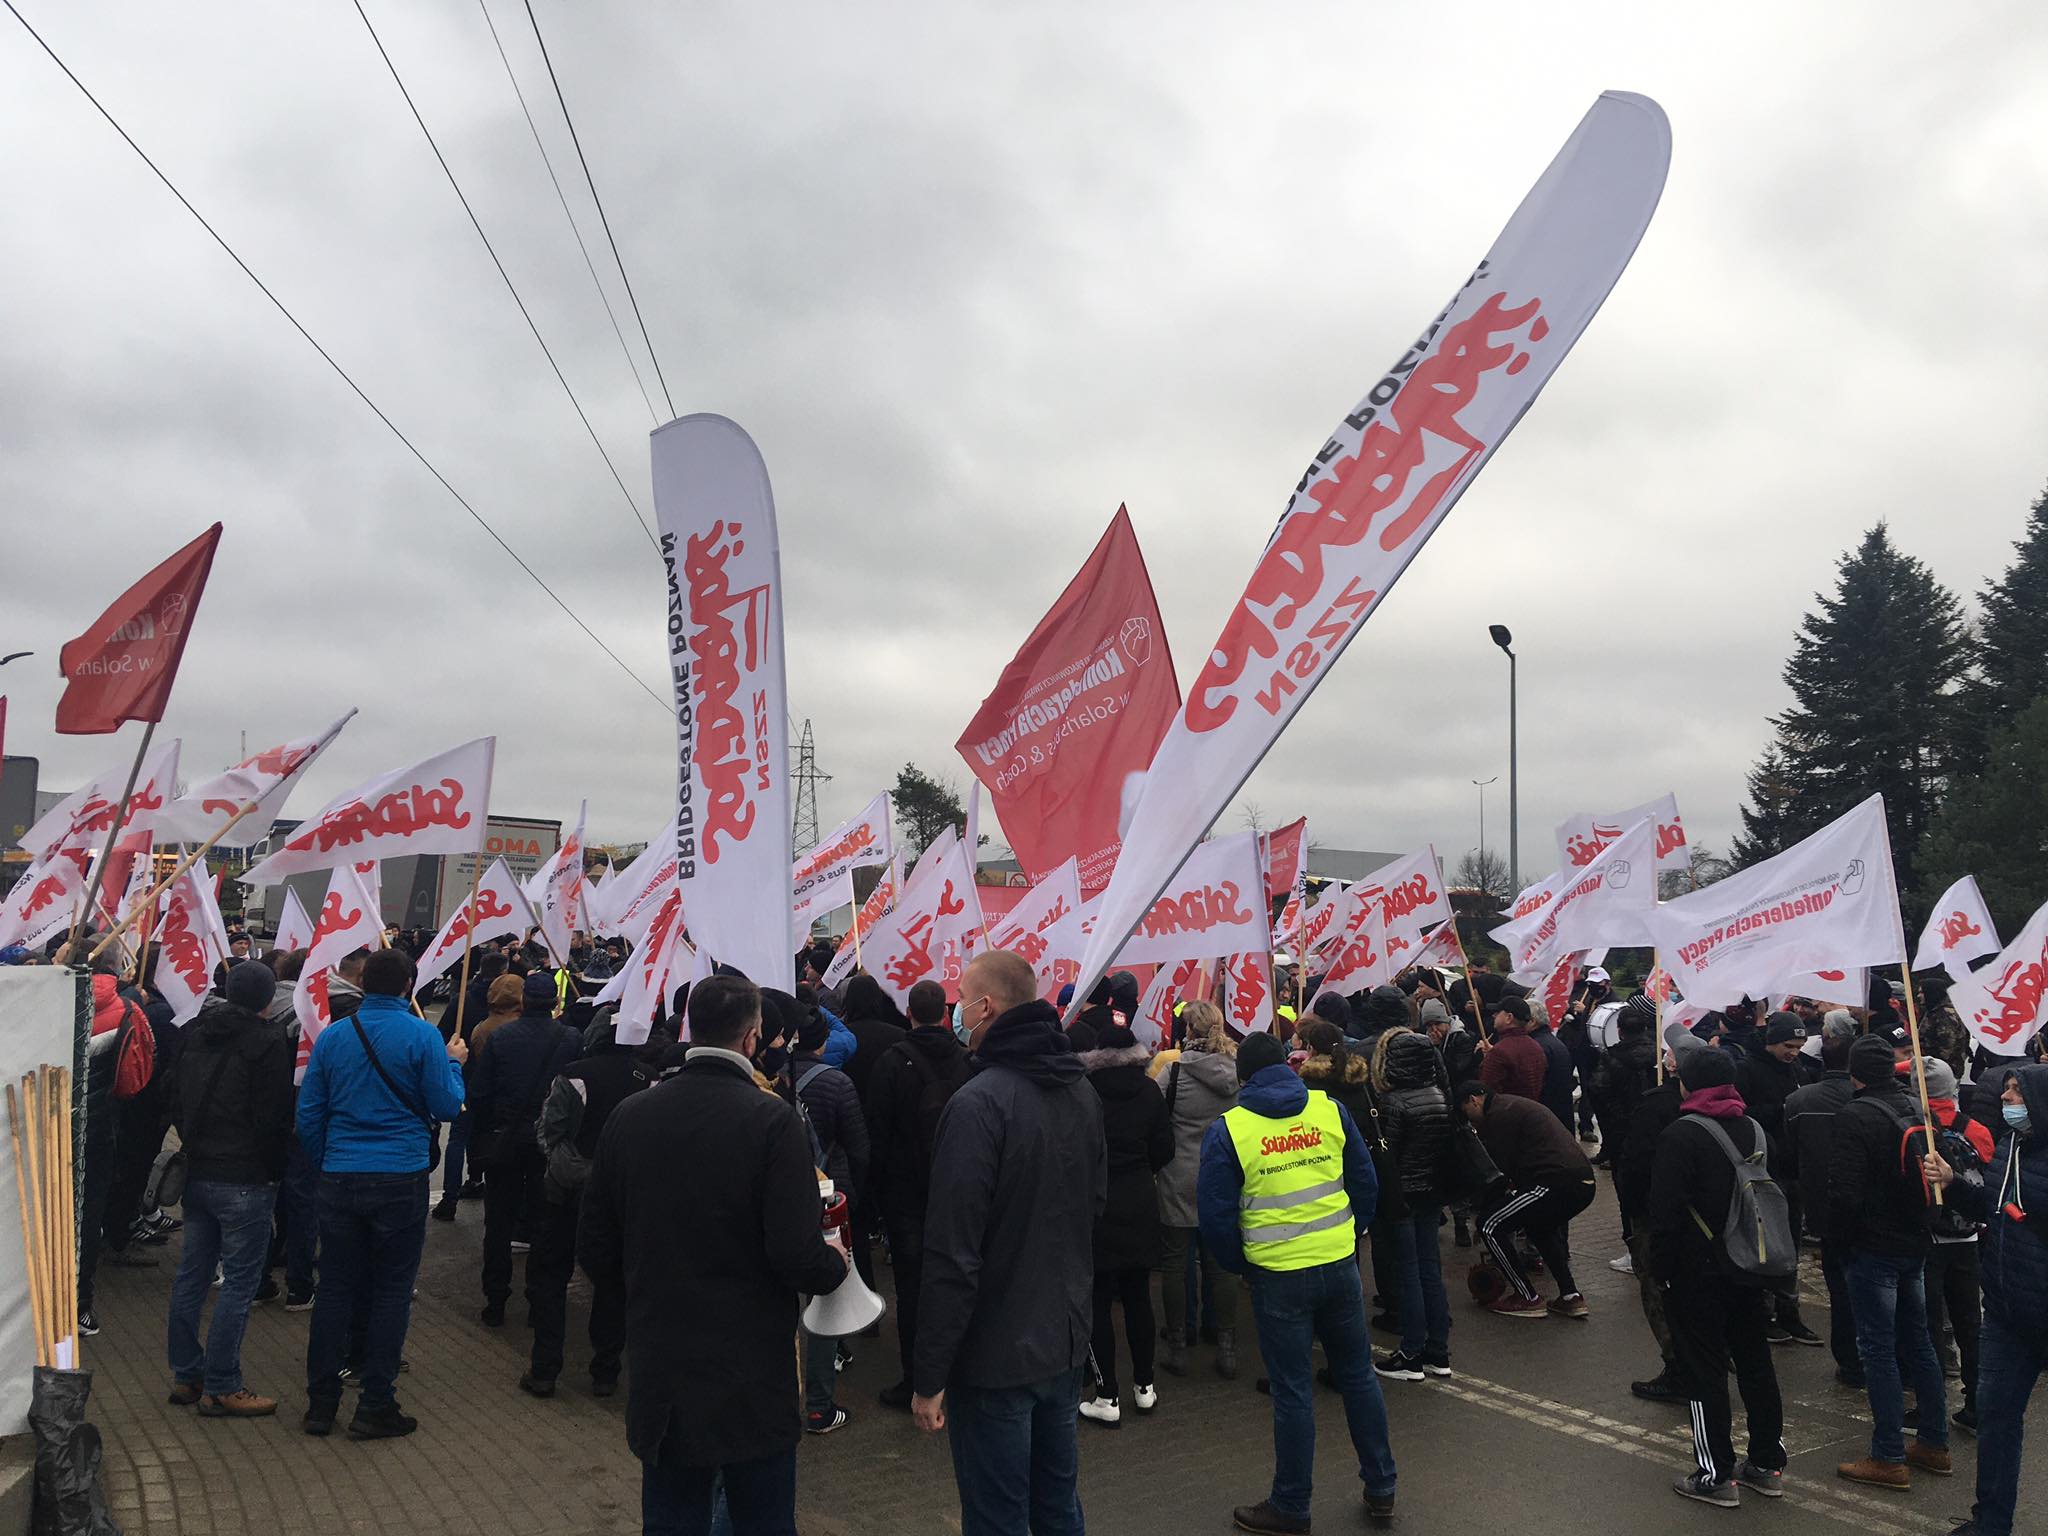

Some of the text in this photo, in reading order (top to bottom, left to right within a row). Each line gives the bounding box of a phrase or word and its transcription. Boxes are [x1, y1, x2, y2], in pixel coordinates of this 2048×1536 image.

[486, 836, 541, 856] OMA
[1259, 1168, 1267, 1176] W
[1267, 1160, 1308, 1175] BRIDGESTONE
